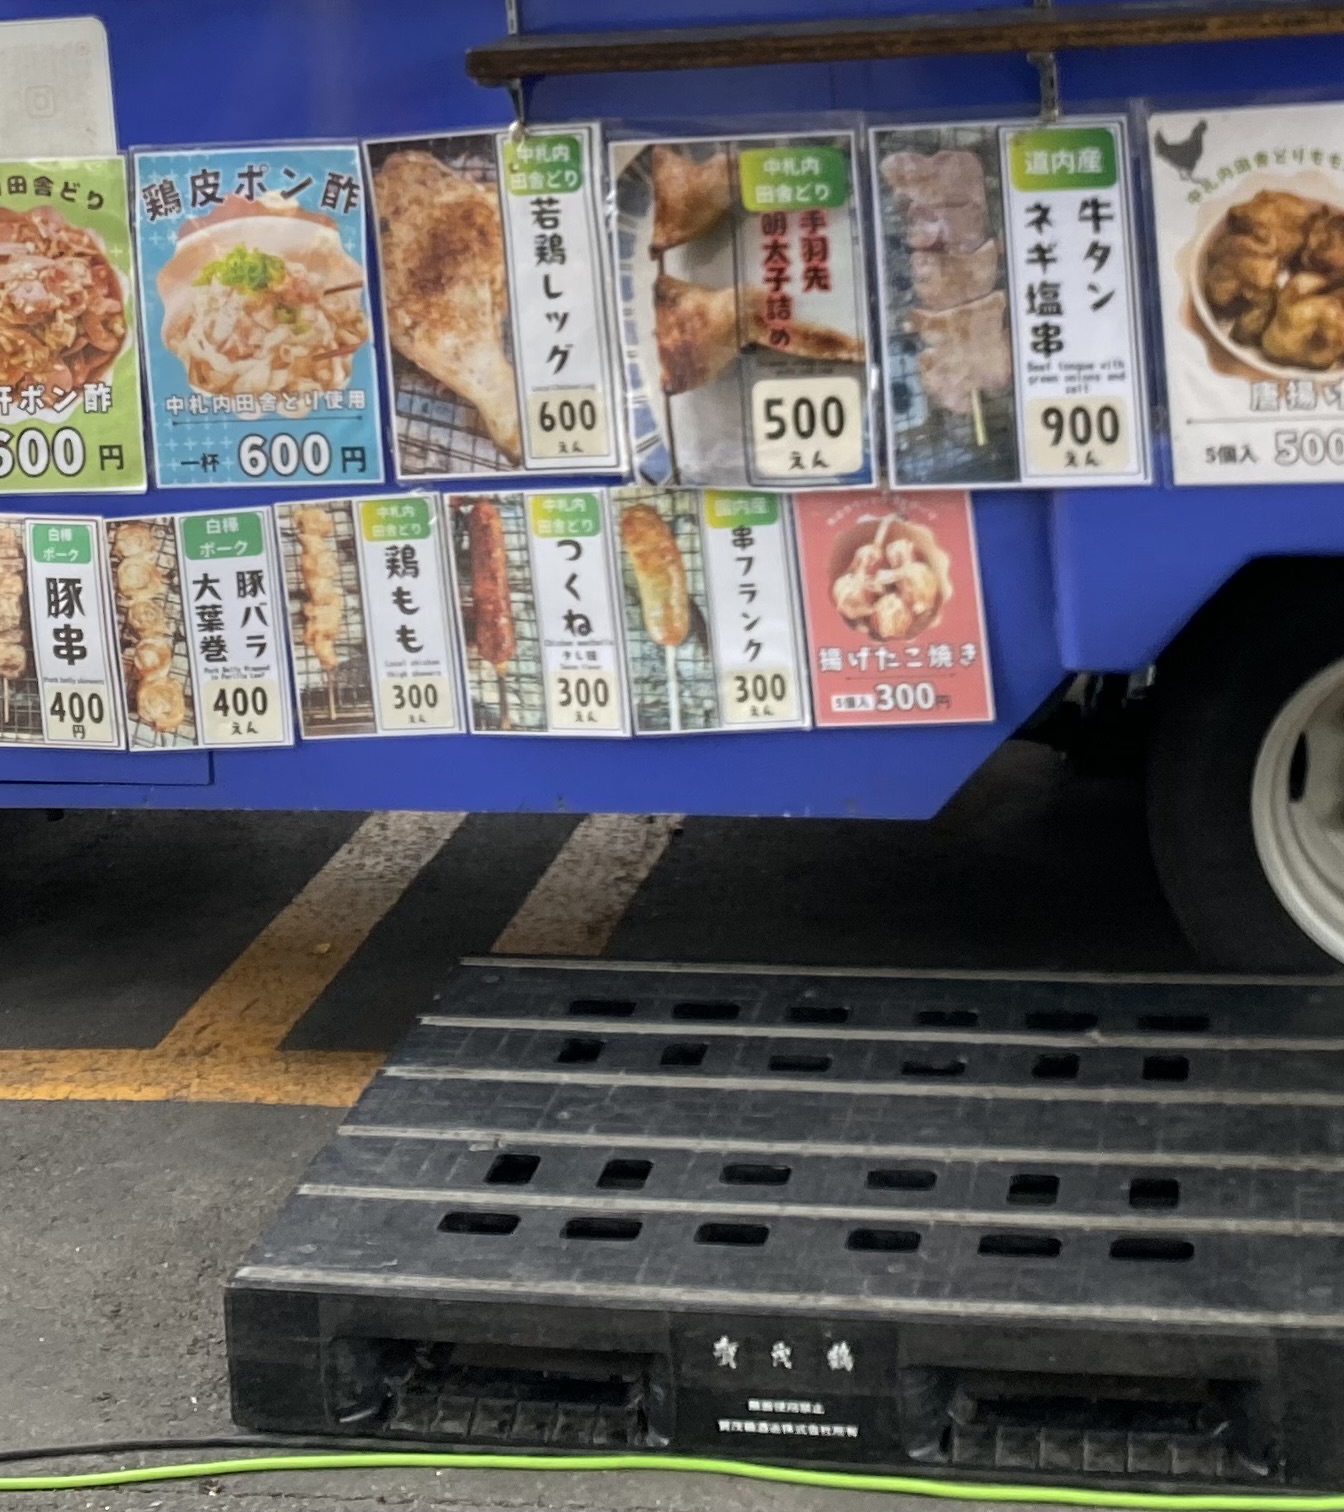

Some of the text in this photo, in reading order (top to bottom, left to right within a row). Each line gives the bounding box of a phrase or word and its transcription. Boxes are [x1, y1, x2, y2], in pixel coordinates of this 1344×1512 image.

[1024, 147, 1104, 176] 道内産
[142, 163, 360, 222] 鶏皮ポン酢
[1079, 197, 1116, 312] 牛タン
[531, 197, 575, 375] 若鶏レッグ
[1024, 202, 1064, 358] ネギ塩串
[538, 398, 596, 433] 600
[763, 395, 845, 440] 500
[1041, 405, 1120, 447] 900
[98, 444, 124, 471] 円
[181, 431, 366, 478] 一杯 600 円
[789, 451, 829, 471] えん
[42, 547, 79, 562] ポーク
[199, 540, 248, 558] ポーク
[384, 544, 423, 654] 鶏もも
[557, 540, 593, 637] つくね
[732, 524, 762, 662] 串フランク
[46, 577, 87, 666] 豚串
[192, 572, 229, 663] 大葉巻
[235, 569, 270, 659] 豚バラ
[819, 642, 976, 672] 揚げたこ焼き
[213, 686, 268, 717] 400
[392, 684, 438, 710] 300
[557, 677, 610, 707] 300
[734, 673, 786, 703] 300
[50, 692, 104, 724] 400
[72, 725, 85, 739] 円
